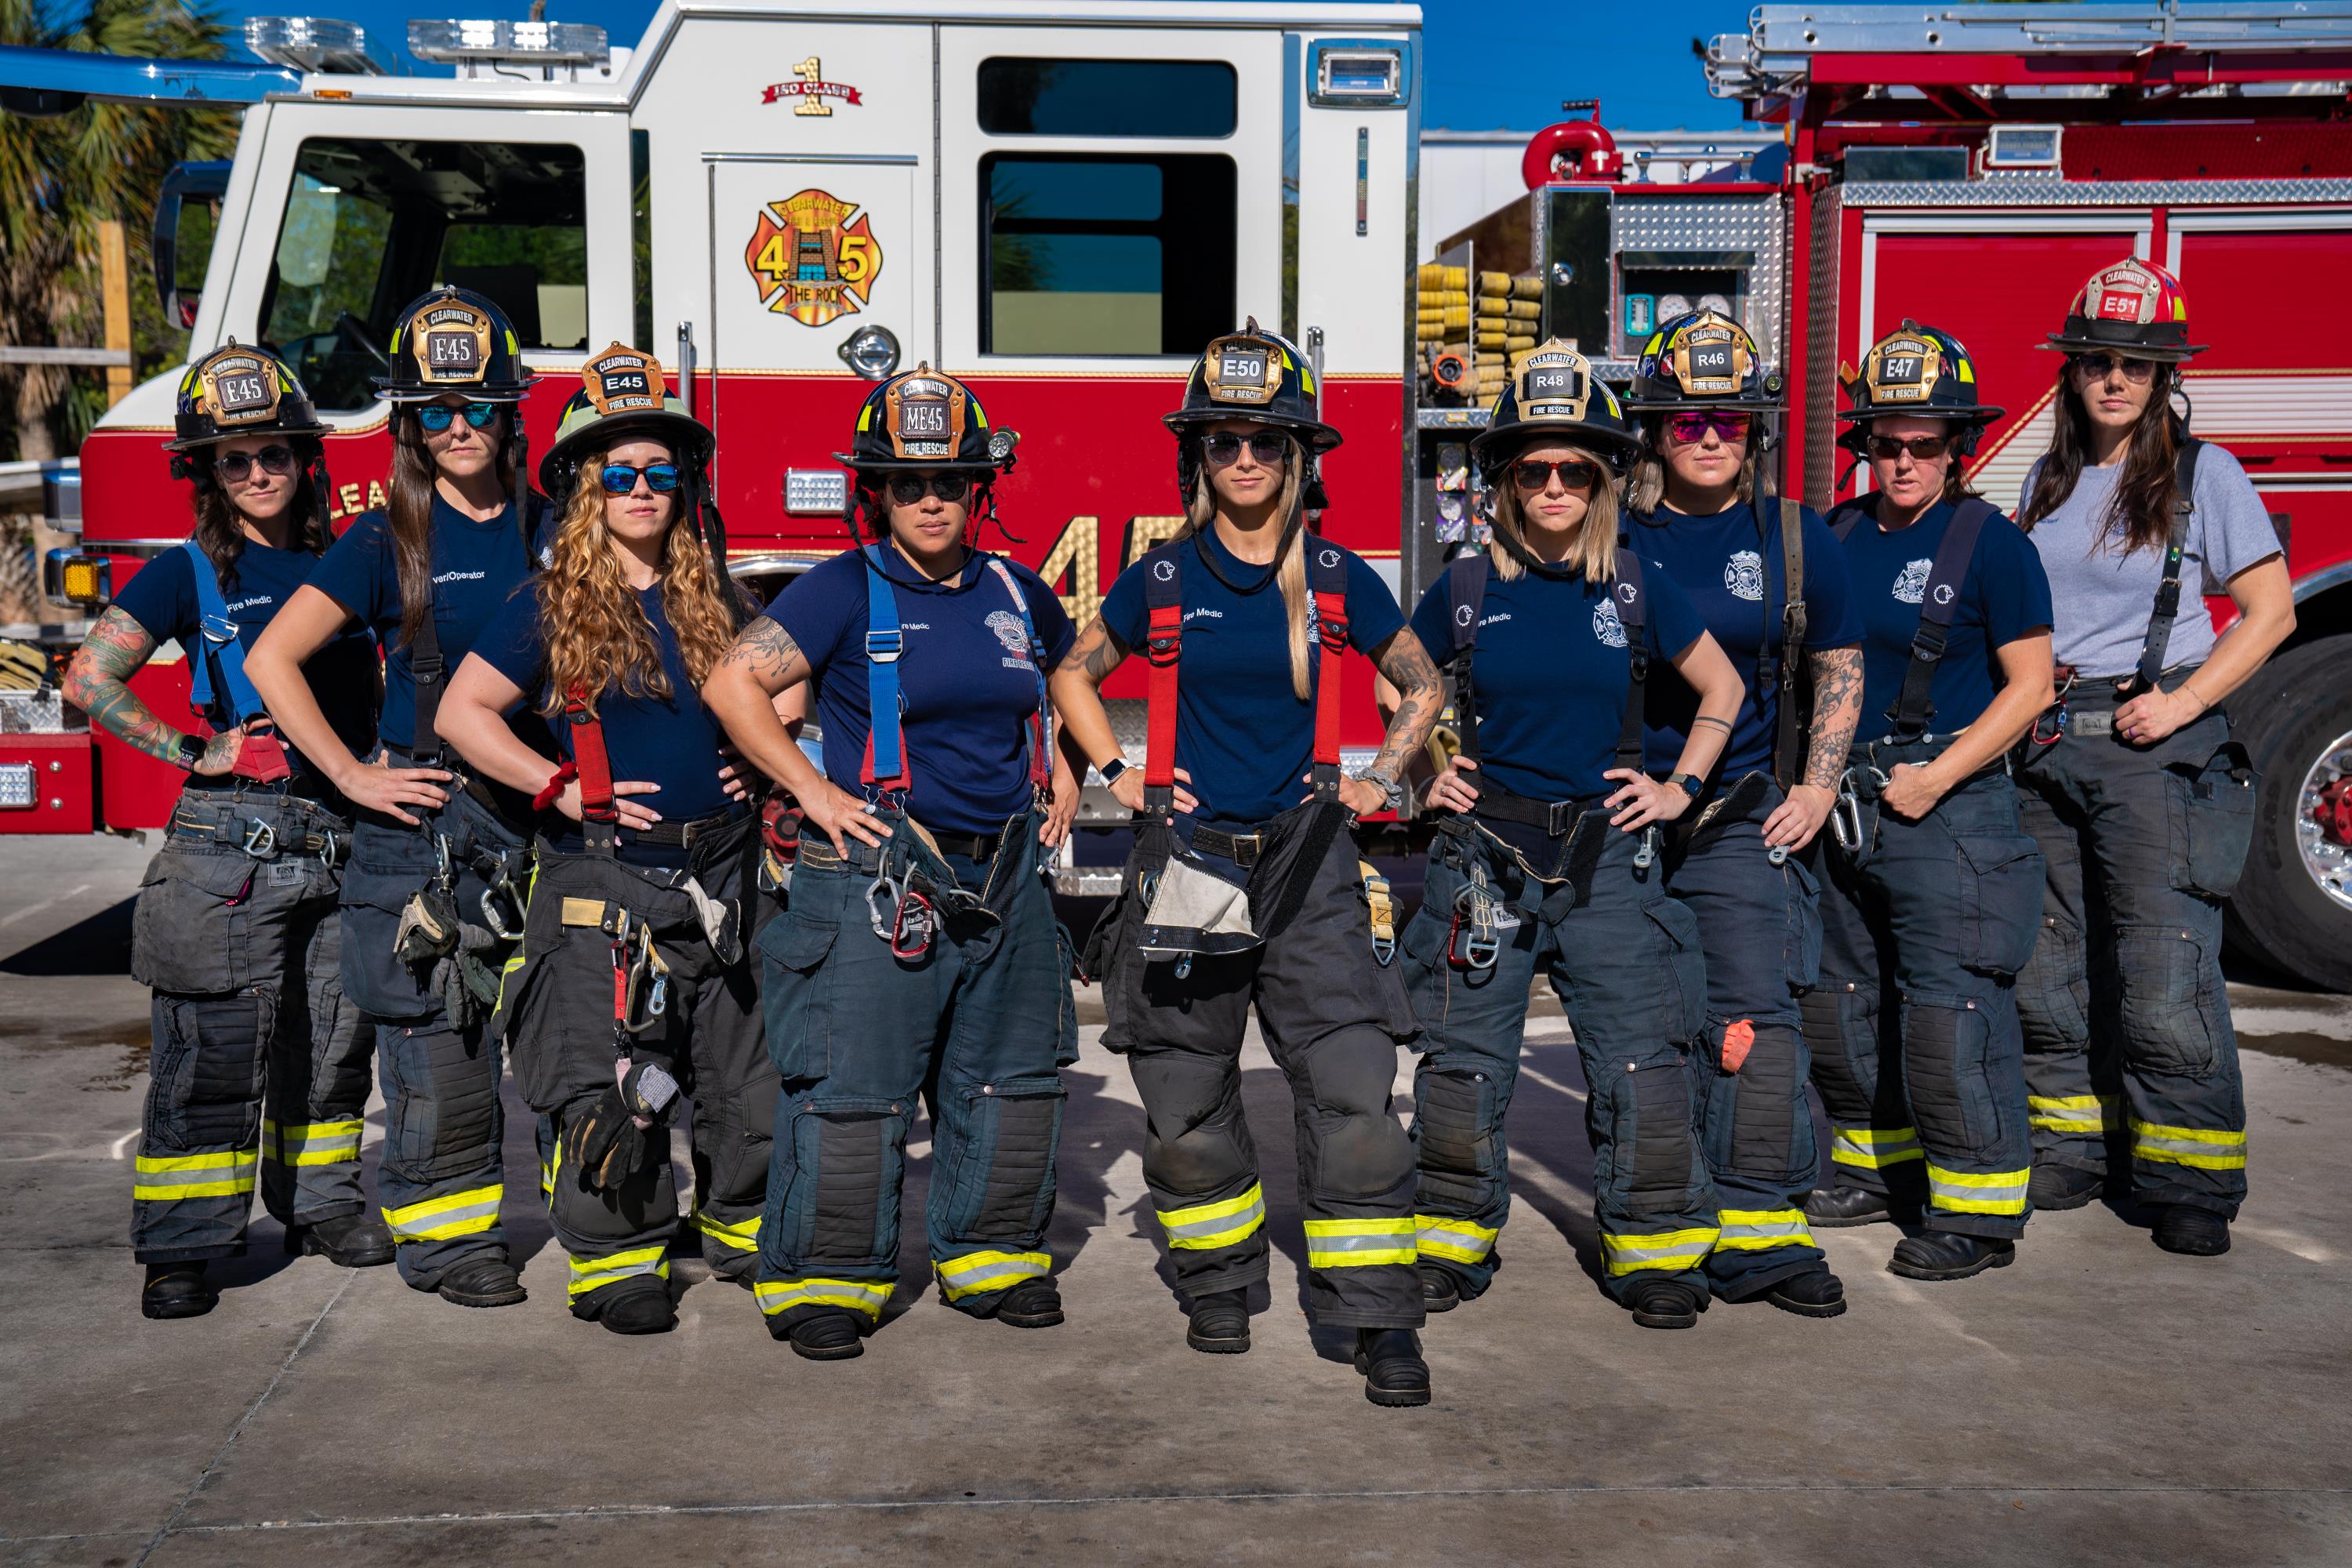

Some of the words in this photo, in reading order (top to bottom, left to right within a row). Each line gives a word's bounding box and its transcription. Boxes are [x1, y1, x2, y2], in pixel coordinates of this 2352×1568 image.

[774, 82, 800, 96] ISO
[803, 82, 850, 96] CLASS
[779, 199, 848, 218] CLEARWATER
[2105, 270, 2146, 288] CLEARWATER
[788, 285, 811, 304] THE
[816, 286, 843, 305] ROCK
[2104, 296, 2137, 314] E51
[430, 309, 474, 325] CLEARWATER
[1691, 330, 1731, 343] CLEARWATER
[434, 338, 470, 361] E45
[1885, 340, 1922, 355] CLEARWATER
[216, 358, 259, 375] CLEARWATER
[599, 356, 643, 372] CLEARWATER
[1530, 354, 1577, 368] CLEARWATER
[1698, 353, 1725, 366] R46
[1223, 360, 1261, 376] E50
[1886, 358, 1915, 377] E47
[606, 376, 643, 390] E45
[1537, 376, 1564, 387] R48
[1693, 382, 1707, 390] FIRE
[1708, 382, 1733, 390] RESCUE
[225, 377, 262, 403] E45
[1221, 390, 1235, 398] FIRE
[1236, 390, 1262, 399] RESCUE
[1882, 390, 1894, 399] FIRE
[1896, 389, 1919, 398] RESCUE
[608, 400, 625, 411] FIRE
[626, 397, 653, 407] RESCUE
[1534, 406, 1546, 415] FIRE
[906, 407, 942, 431] ME45
[905, 442, 920, 455] FIRE
[922, 442, 949, 455] RESCUE
[433, 571, 485, 584] ver/Operator
[226, 602, 244, 614] Fire
[245, 595, 272, 607] Medic
[1196, 608, 1223, 618] Medic
[1488, 613, 1512, 624] Medic
[1003, 658, 1018, 668] FIRE
